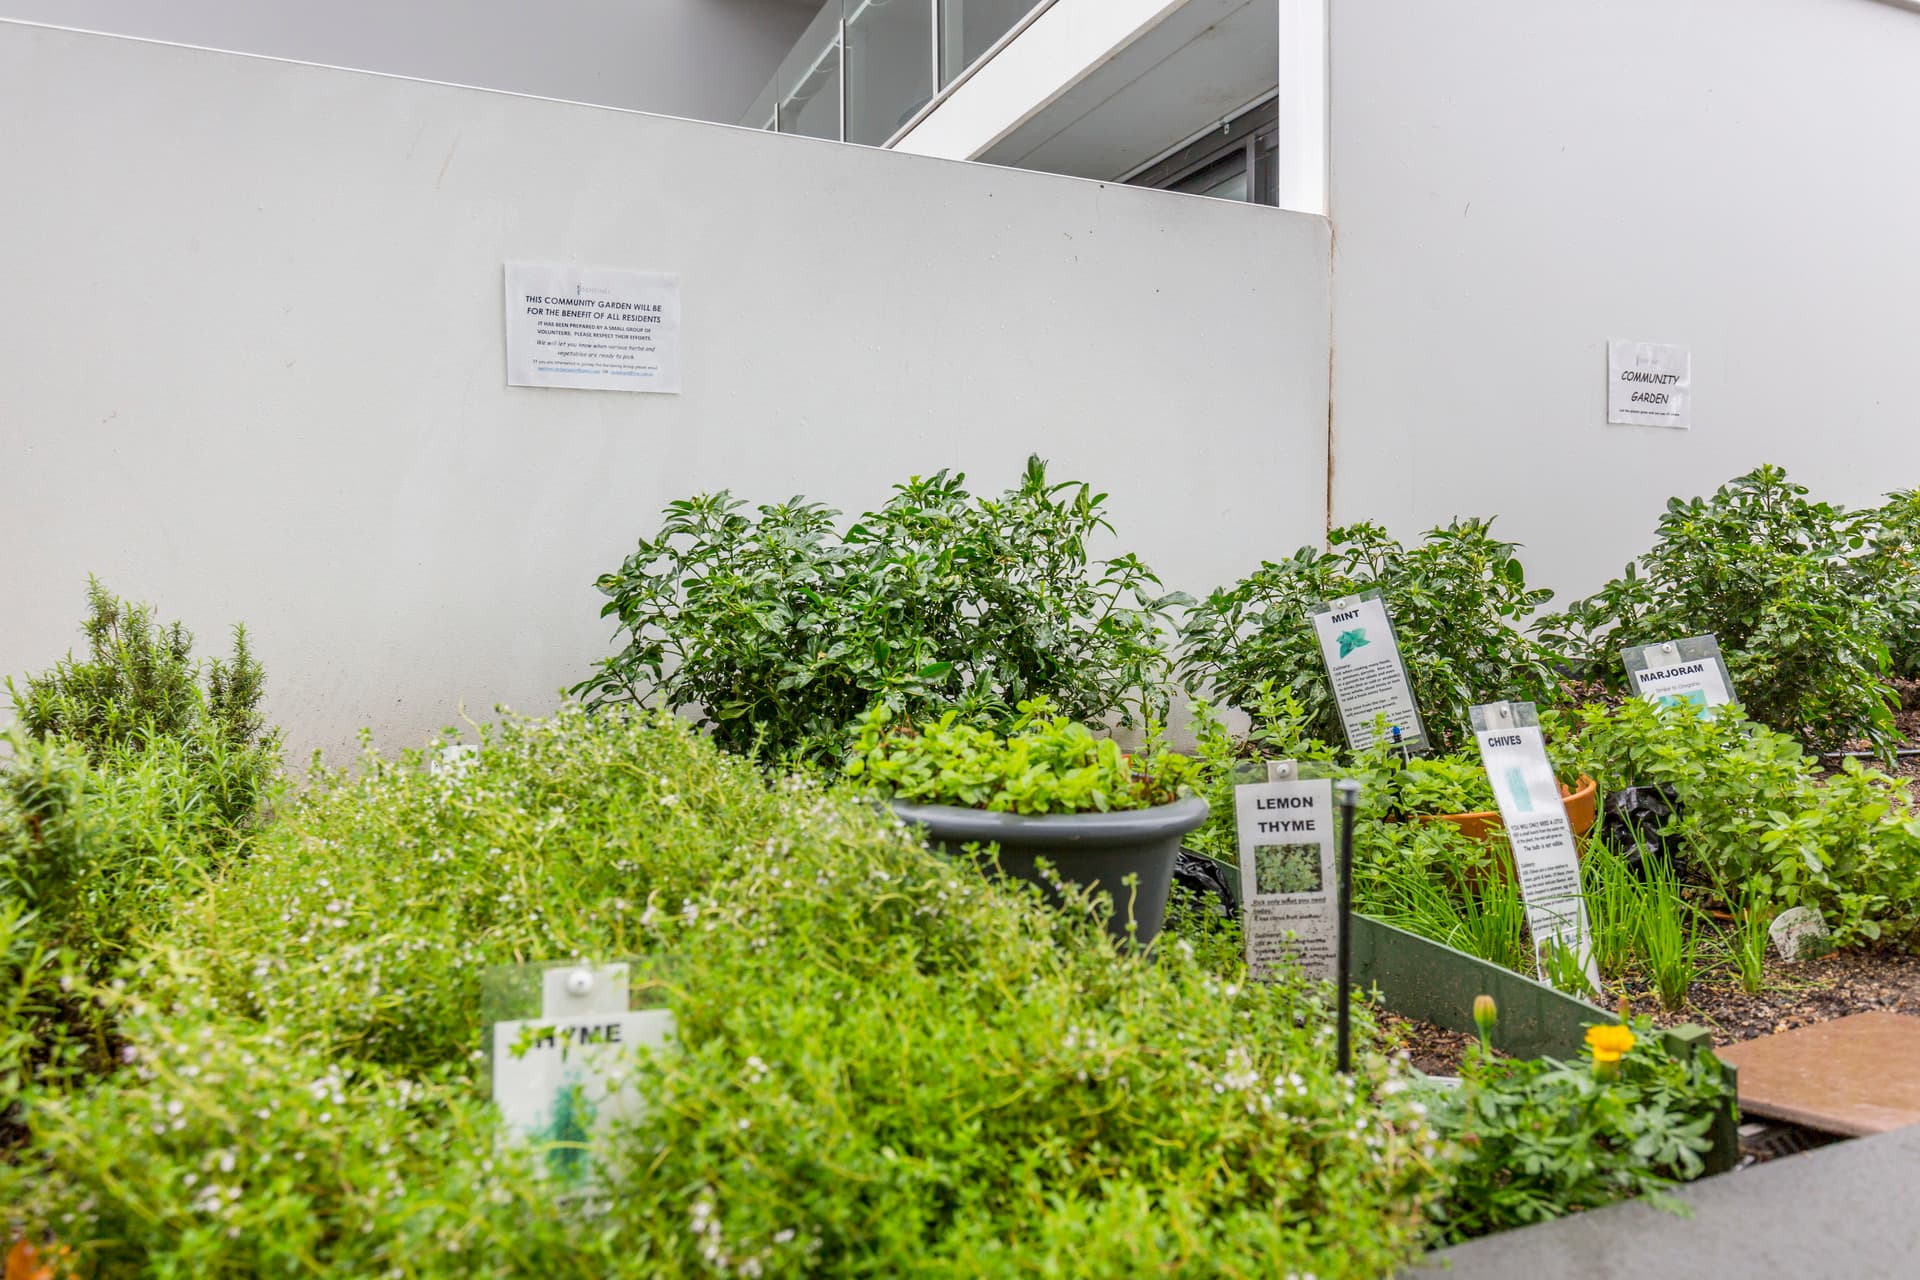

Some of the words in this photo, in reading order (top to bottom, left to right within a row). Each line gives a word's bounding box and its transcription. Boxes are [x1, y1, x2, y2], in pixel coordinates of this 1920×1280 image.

[526, 296, 542, 304] THIS
[545, 297, 596, 307] COMMUNITY
[598, 301, 632, 310] GARDEN
[562, 310, 591, 318] BENEFIT
[622, 314, 660, 323] RESIDENTS
[1621, 370, 1680, 384] COMMUNITY
[1631, 392, 1669, 404] GARDEN
[1332, 610, 1360, 624] MINT
[1640, 664, 1704, 682] MARJORAM
[1488, 735, 1522, 747] CHIVES
[1257, 796, 1313, 810] LEMON
[1258, 820, 1316, 833] THYME
